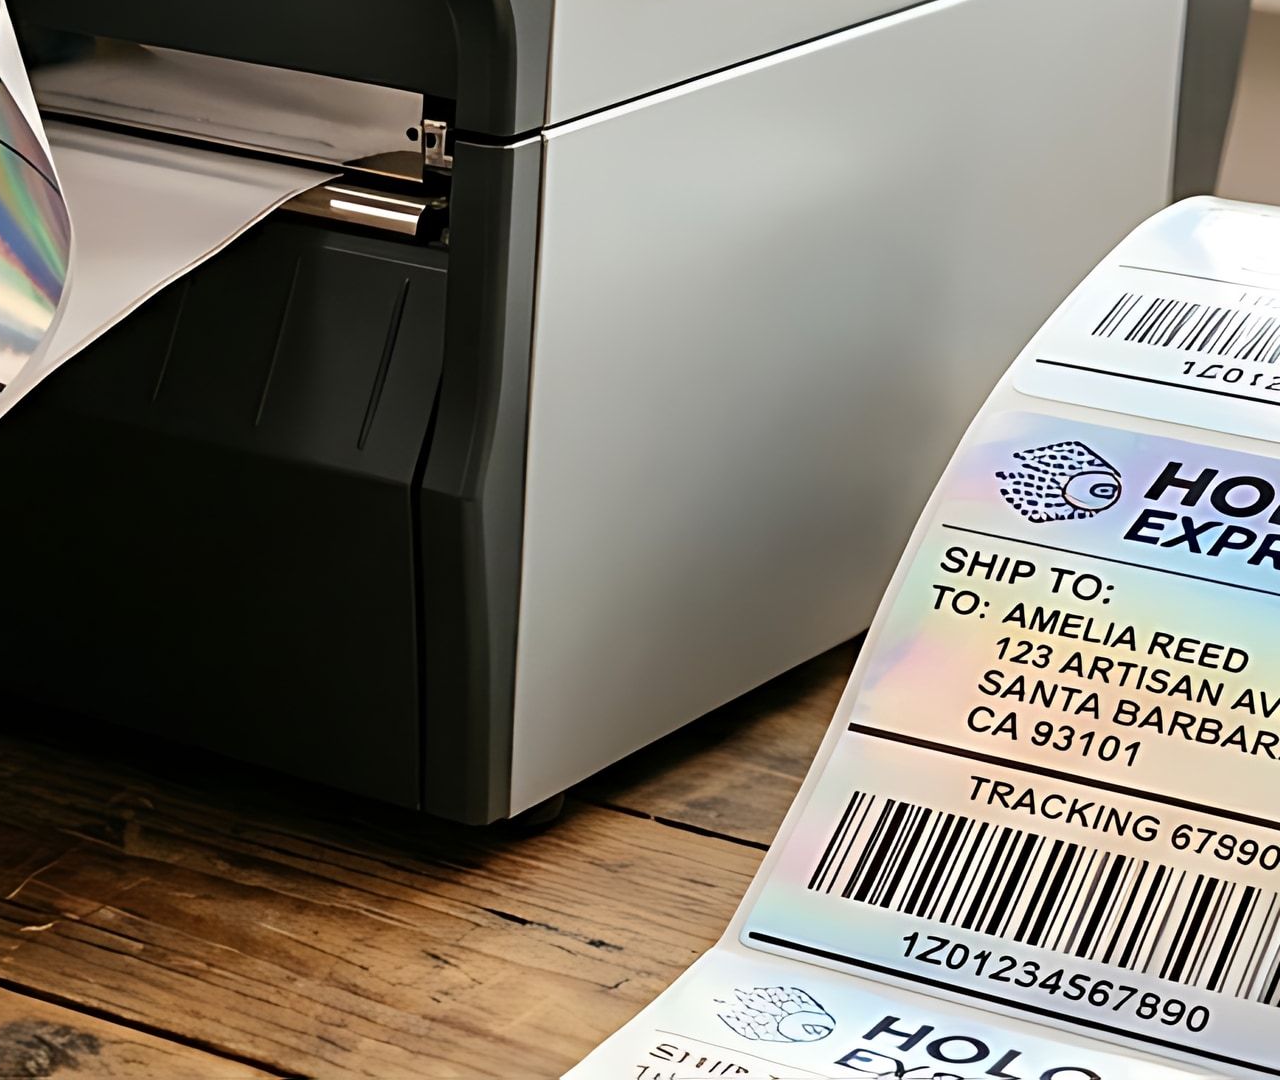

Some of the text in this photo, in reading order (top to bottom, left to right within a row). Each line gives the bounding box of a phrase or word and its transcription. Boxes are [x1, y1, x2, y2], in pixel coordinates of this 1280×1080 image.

[1143, 461, 1280, 526] HO
[940, 546, 1115, 605] SHIP TO:
[932, 584, 1249, 674] TO: AMELIA REED
[996, 637, 1054, 669] 123
[1058, 651, 1225, 707] ARTISAN
[967, 705, 1141, 767] CA 93101
[977, 669, 1280, 761] SANTA BARBAR
[970, 775, 1161, 842] TRACKING
